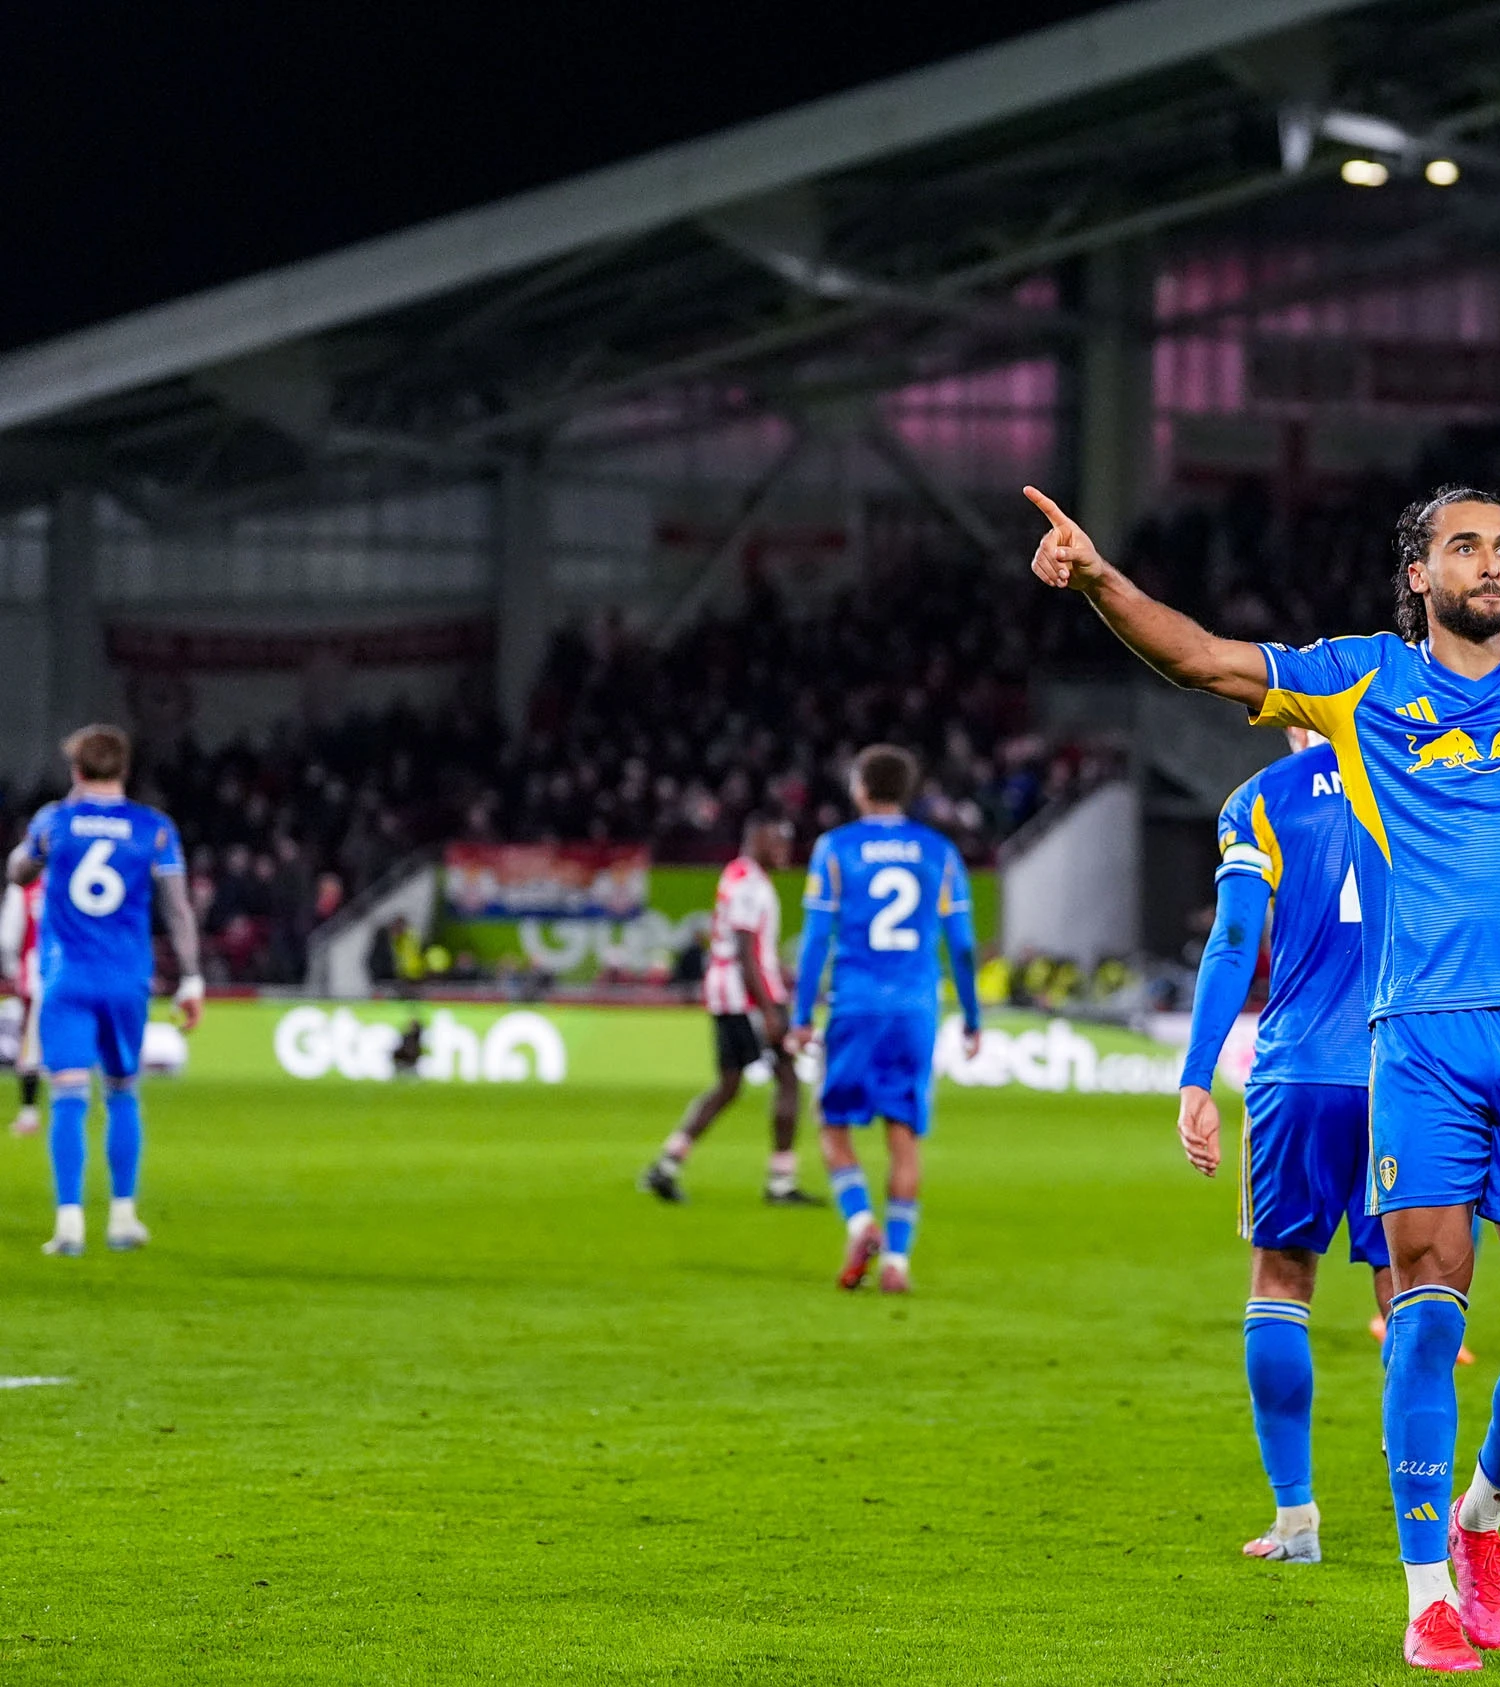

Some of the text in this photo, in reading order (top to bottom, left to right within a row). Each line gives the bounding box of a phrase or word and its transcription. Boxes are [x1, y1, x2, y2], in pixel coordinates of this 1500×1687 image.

[69, 838, 126, 917] 6
[868, 866, 921, 952] 2
[1395, 1460, 1448, 1476] LUFC
